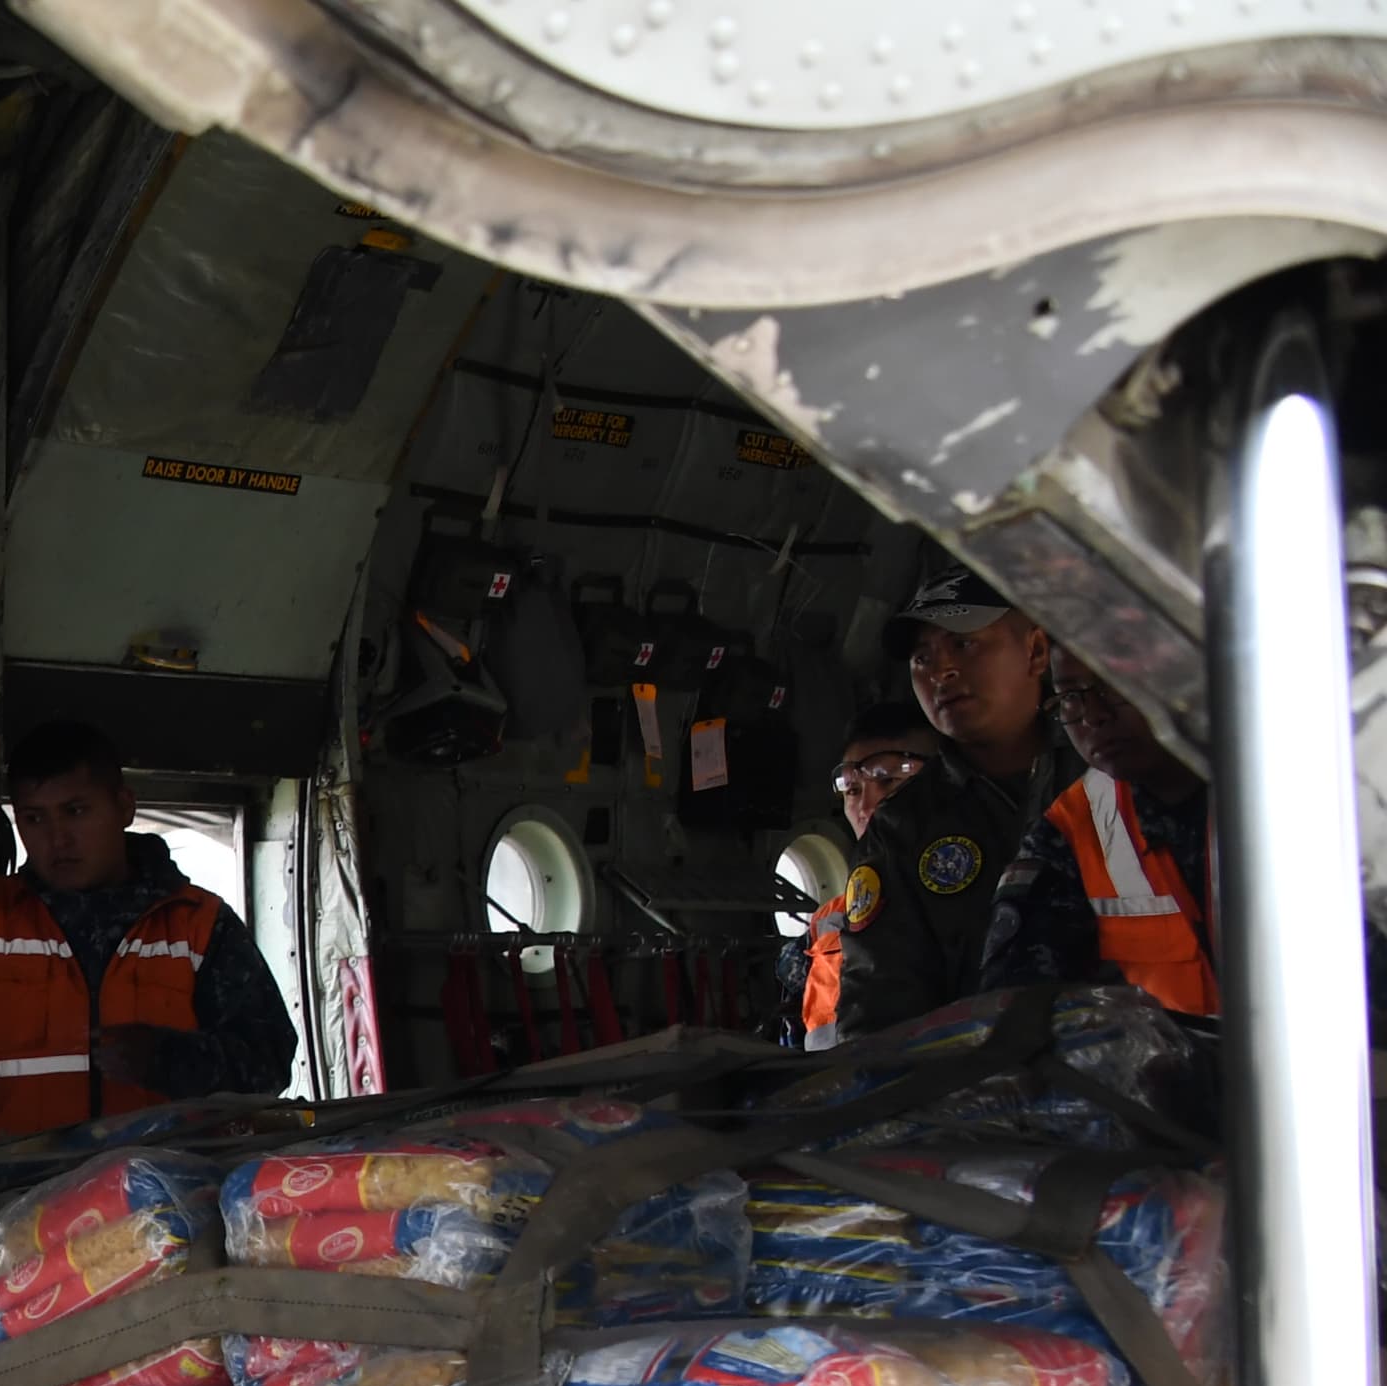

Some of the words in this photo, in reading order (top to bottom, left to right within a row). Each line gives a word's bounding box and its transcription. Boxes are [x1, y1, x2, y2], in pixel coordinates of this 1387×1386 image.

[554, 424, 606, 442] MERGENCY
[145, 458, 184, 479] RAISE
[185, 464, 226, 485] DOOR
[228, 469, 247, 486] BY
[247, 473, 300, 493] HANDLE
